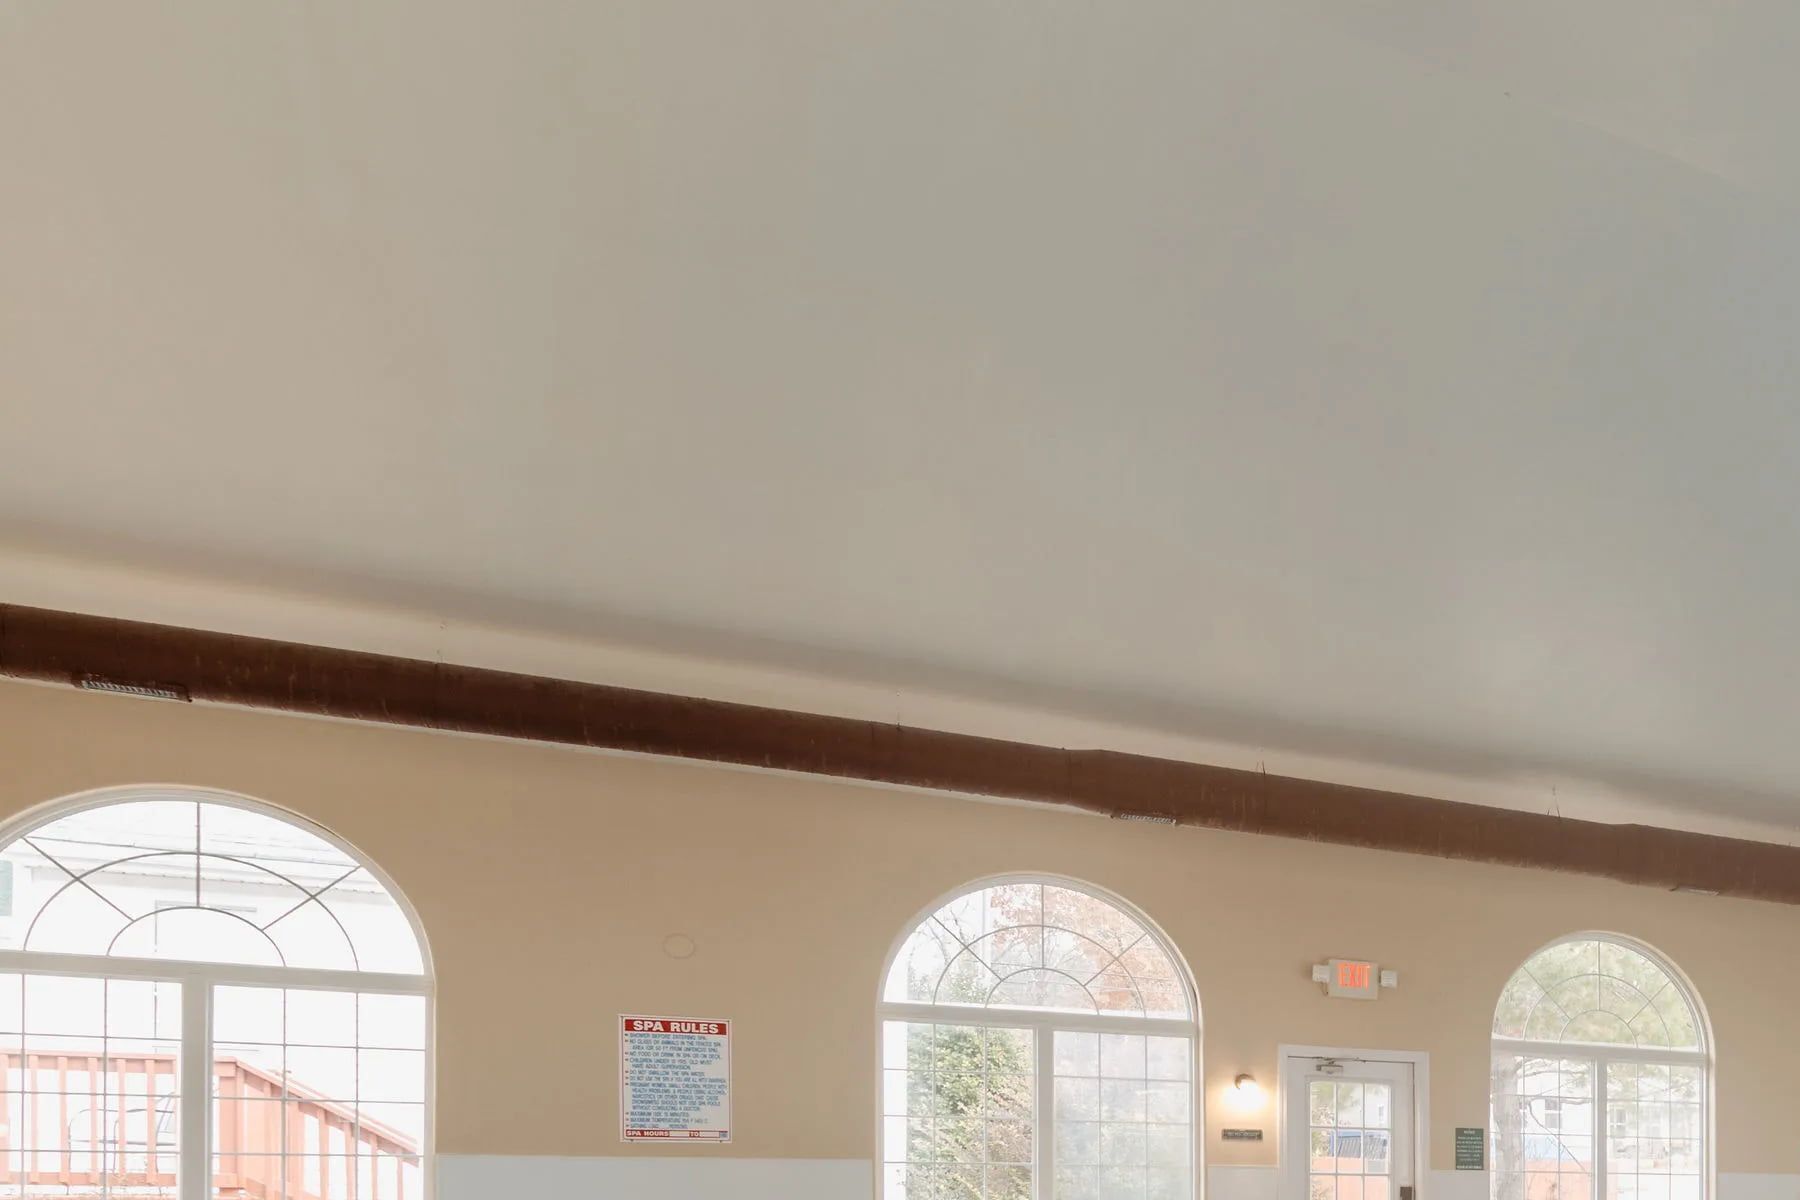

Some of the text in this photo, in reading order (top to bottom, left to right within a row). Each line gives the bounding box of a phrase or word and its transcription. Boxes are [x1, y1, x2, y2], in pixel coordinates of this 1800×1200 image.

[1337, 962, 1370, 990] EXIT
[633, 1020, 719, 1034] SPA RULES
